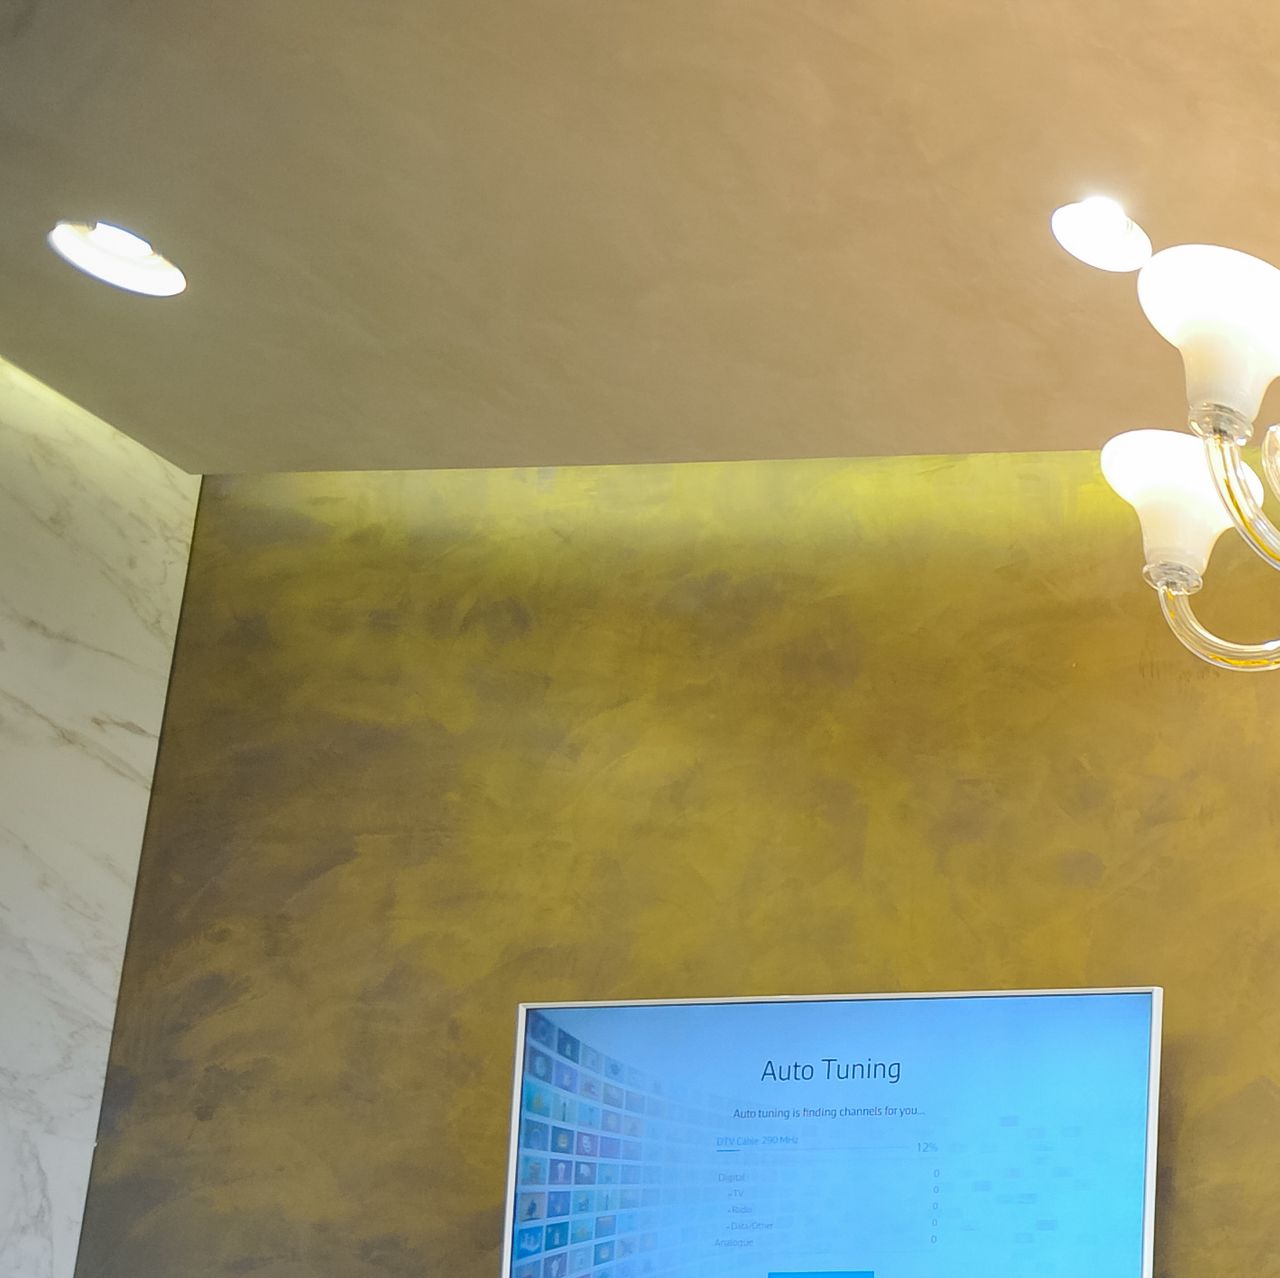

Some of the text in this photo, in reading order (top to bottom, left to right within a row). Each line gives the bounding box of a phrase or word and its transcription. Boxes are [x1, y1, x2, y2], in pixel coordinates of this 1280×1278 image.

[760, 1057, 901, 1084] Auto Tuning
[733, 1109, 757, 1119] Auto
[758, 1109, 790, 1121] tuning
[793, 1108, 801, 1118] is
[803, 1107, 837, 1120] finding
[839, 1106, 882, 1117] channels
[884, 1106, 898, 1117] for
[716, 1136, 735, 1147] DTV
[761, 1135, 778, 1145] 290
[779, 1135, 799, 1145] MHz
[916, 1142, 939, 1153] 12%
